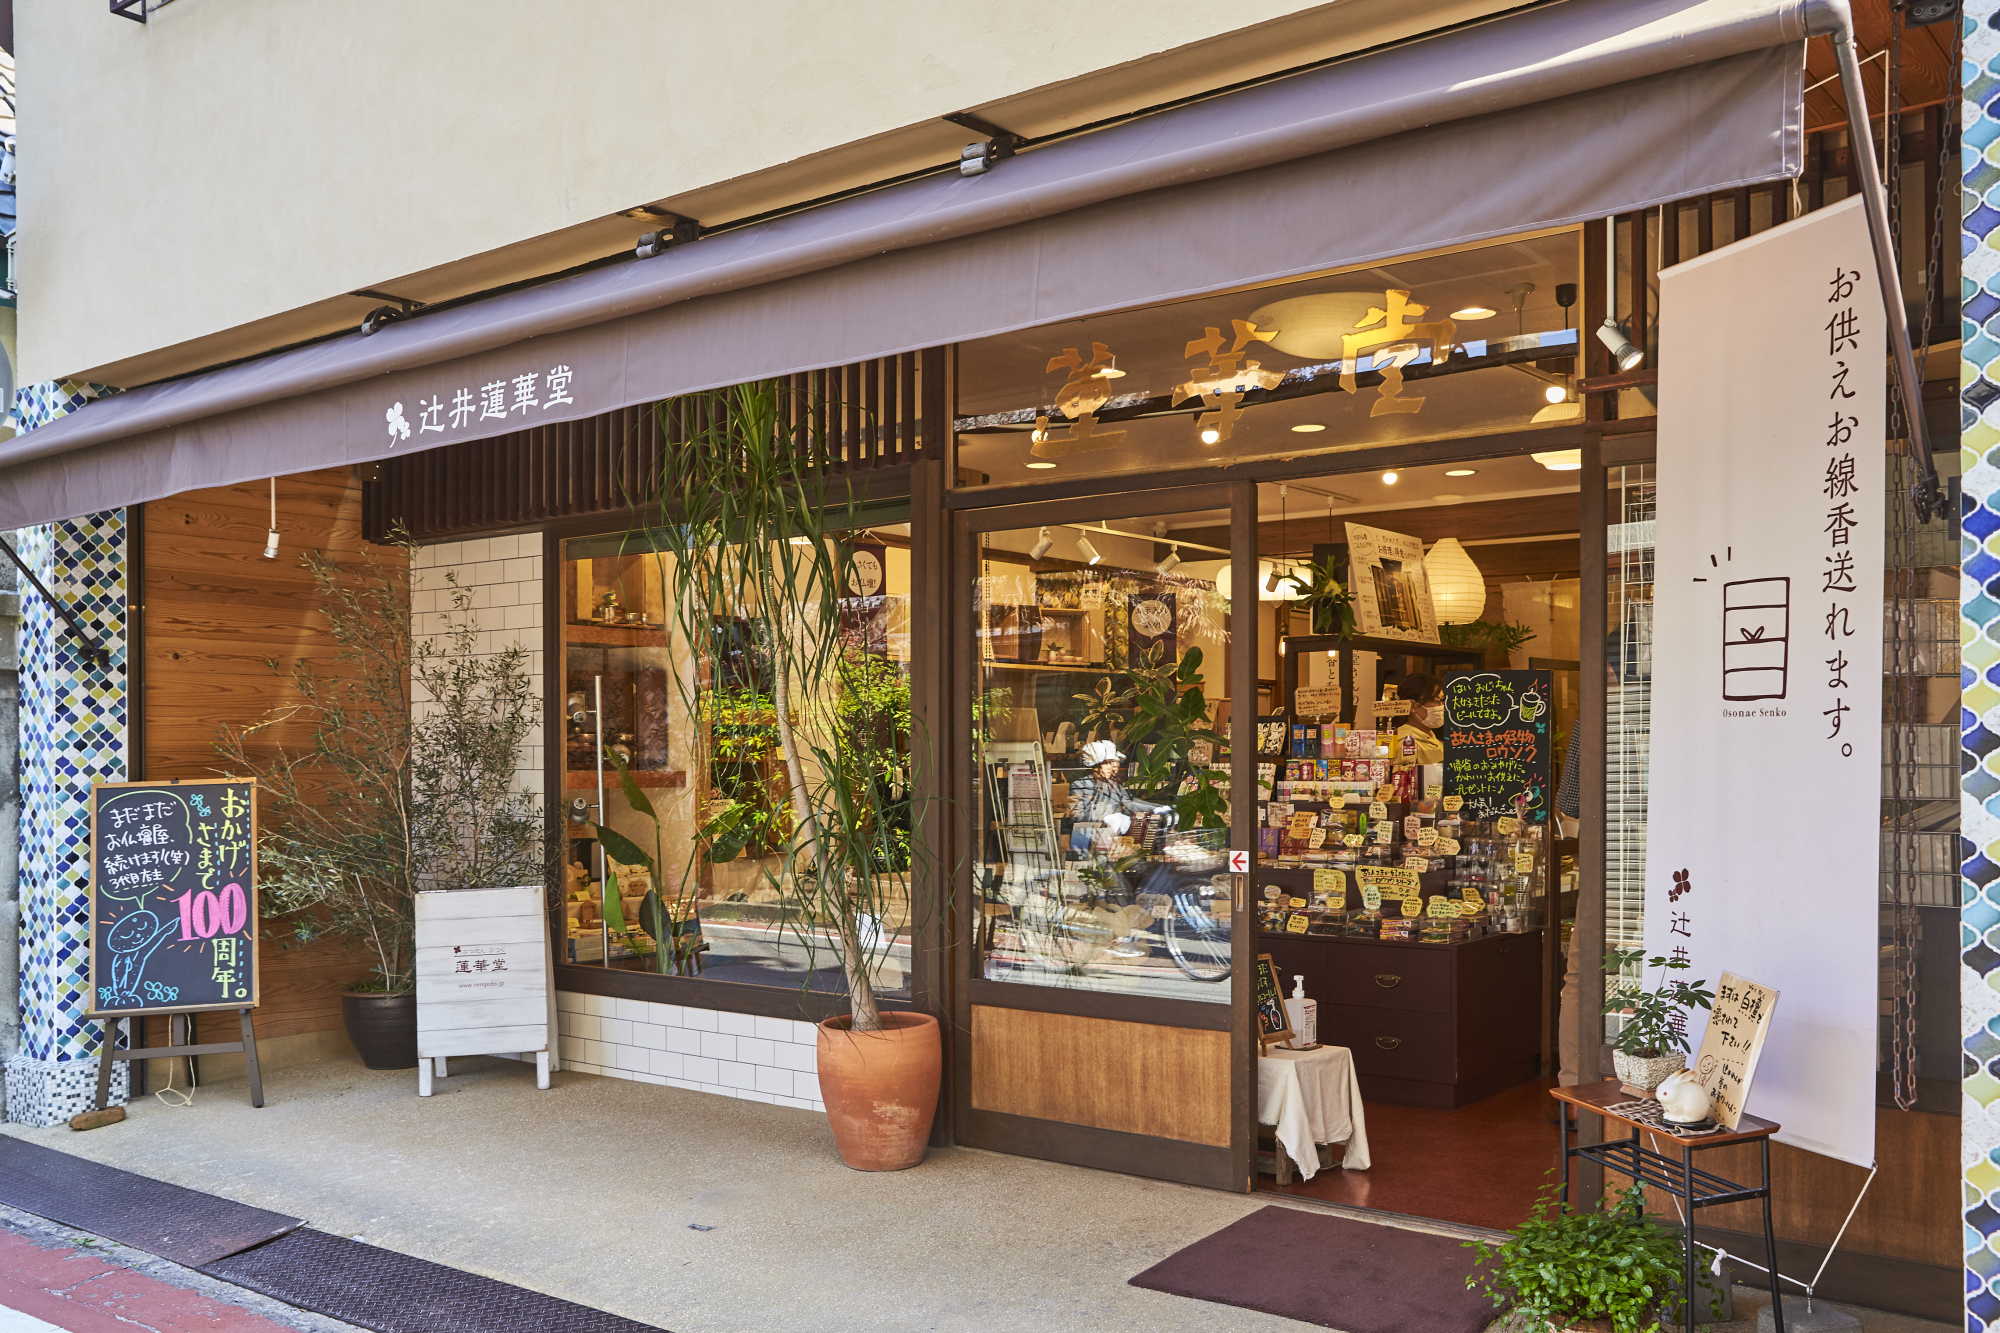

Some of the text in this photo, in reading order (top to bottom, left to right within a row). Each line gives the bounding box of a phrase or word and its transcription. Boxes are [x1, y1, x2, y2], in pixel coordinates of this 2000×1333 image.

[419, 364, 574, 434] 辻井蓮華堂
[1822, 267, 1861, 758] お供えお線香送れます。
[855, 560, 878, 570] さくても
[1452, 693, 1501, 710] 大好きだった
[1722, 706, 1787, 717] Osonae Senko
[1450, 729, 1535, 746] 故人さまの好物
[1486, 745, 1538, 762] ロウソク
[196, 821, 216, 890] さまで
[219, 787, 247, 870] おかげ
[170, 882, 247, 941] 100
[211, 937, 247, 999] 周年。
[455, 958, 508, 973] 蓮華堂
[1669, 911, 1692, 1054] 辻井華
